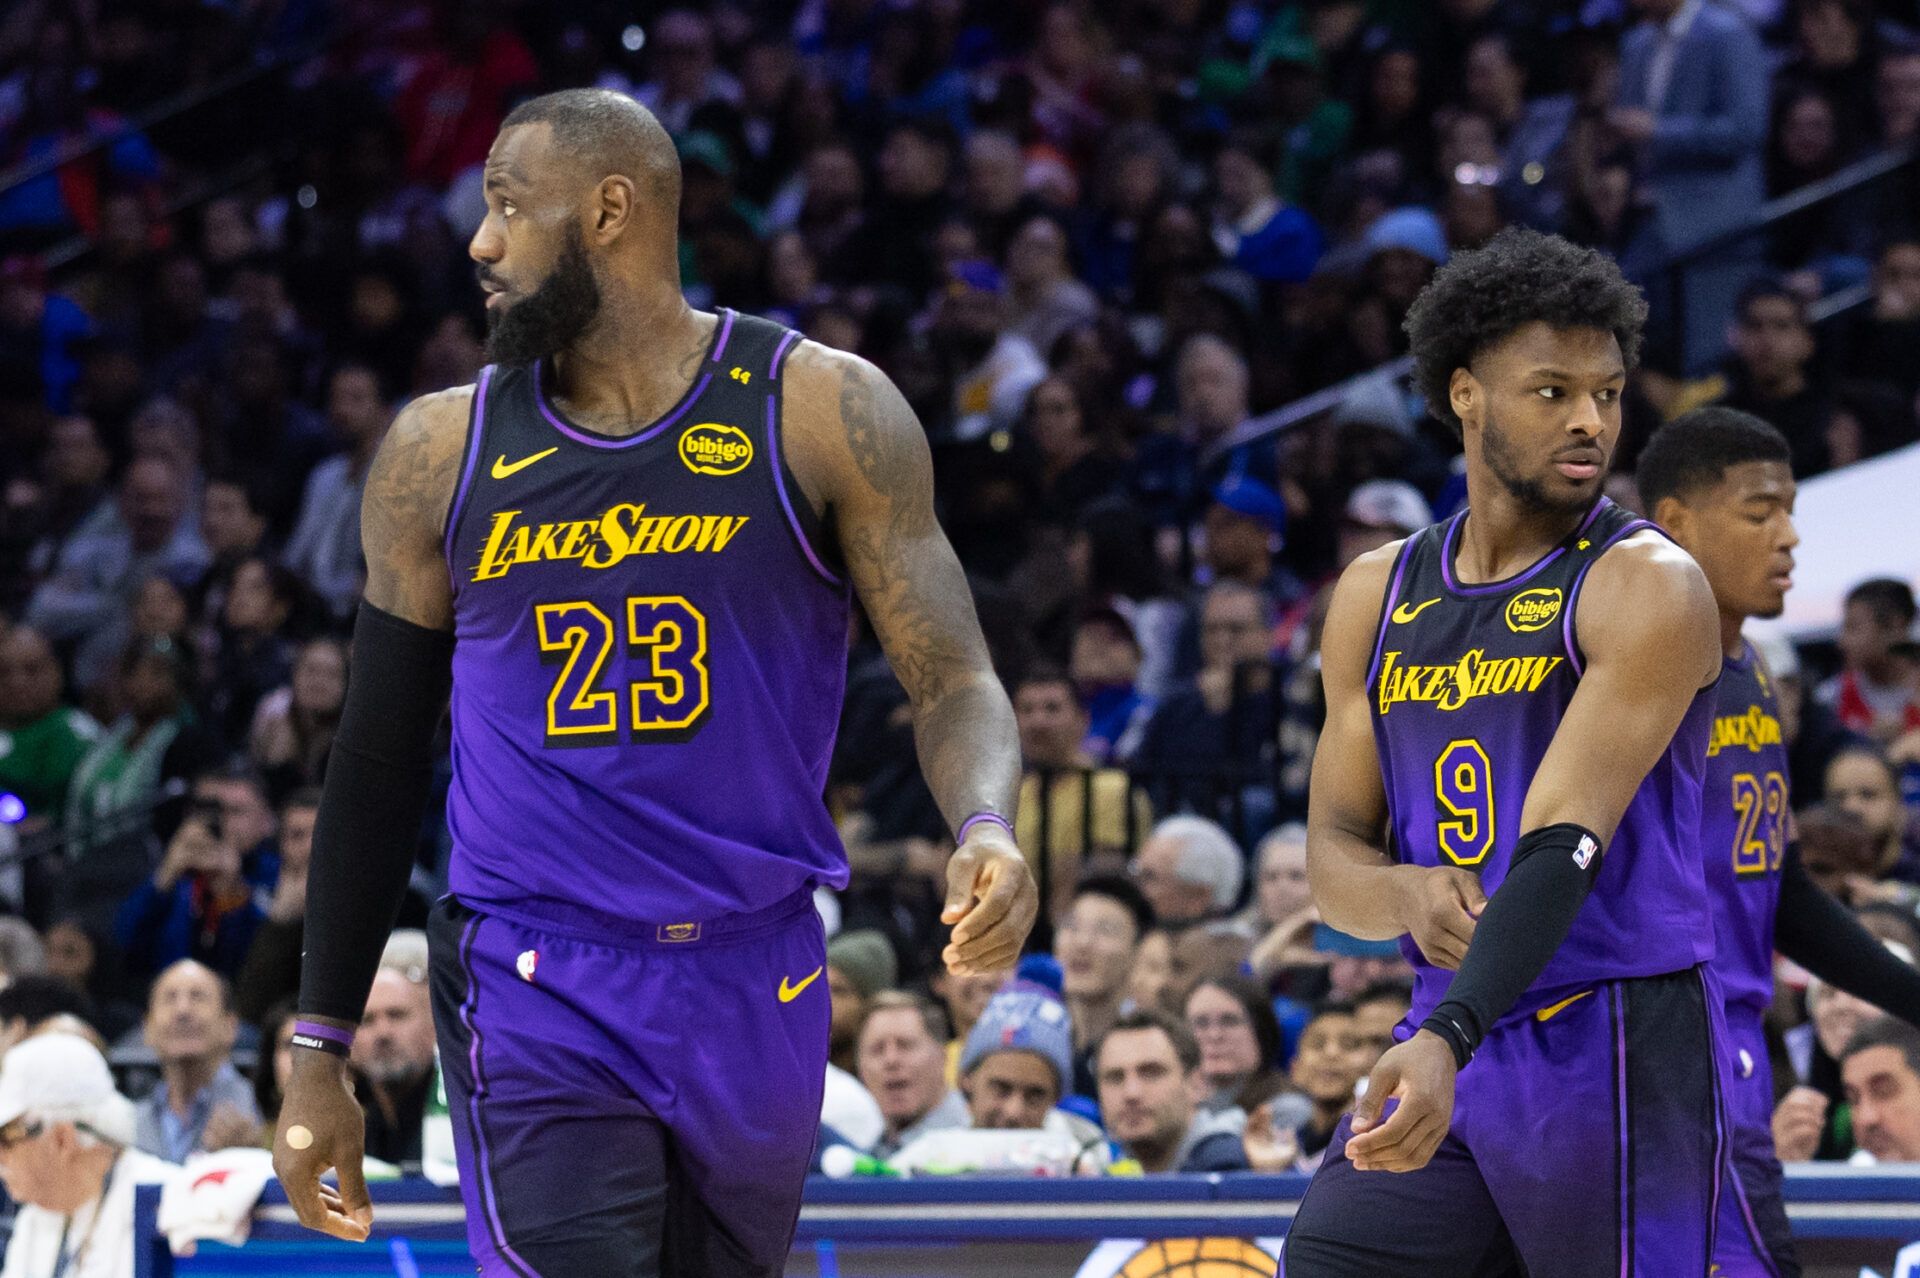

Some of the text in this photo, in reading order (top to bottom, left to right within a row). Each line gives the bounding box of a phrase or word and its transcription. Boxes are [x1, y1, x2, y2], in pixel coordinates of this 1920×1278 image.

[686, 436, 749, 462] bibigo
[1512, 600, 1560, 618] bibigo
[535, 596, 711, 741] 23
[1434, 739, 1495, 866] 9
[1732, 771, 1788, 874] 23
